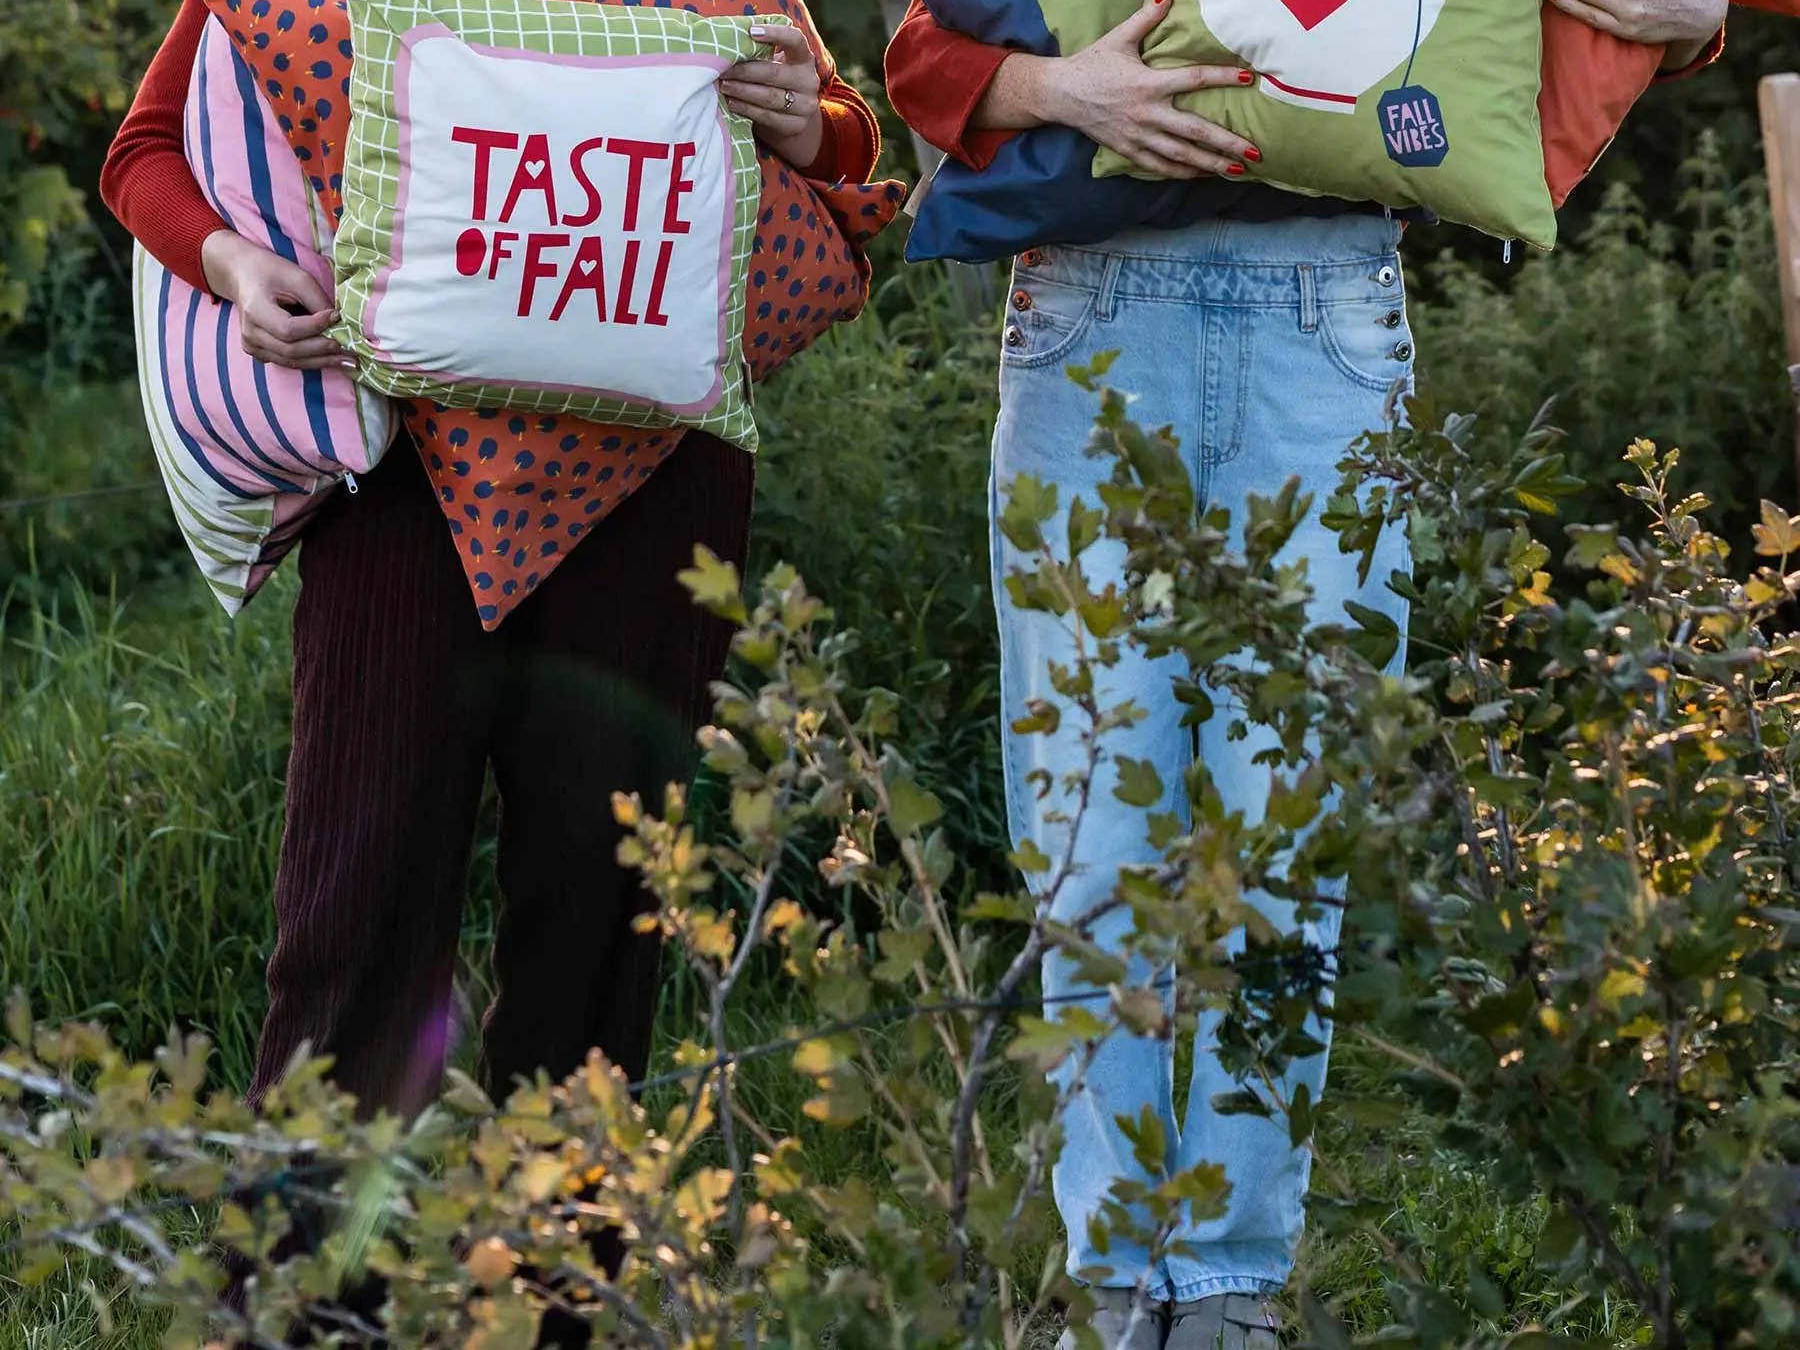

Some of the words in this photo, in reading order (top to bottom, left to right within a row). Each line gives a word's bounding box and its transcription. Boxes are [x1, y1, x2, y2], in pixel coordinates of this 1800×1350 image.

[1386, 98, 1436, 131] FALL
[1386, 122, 1445, 154] VIBES
[451, 126, 696, 234] TASTE
[456, 227, 519, 280] OF
[517, 233, 674, 326] FALL
